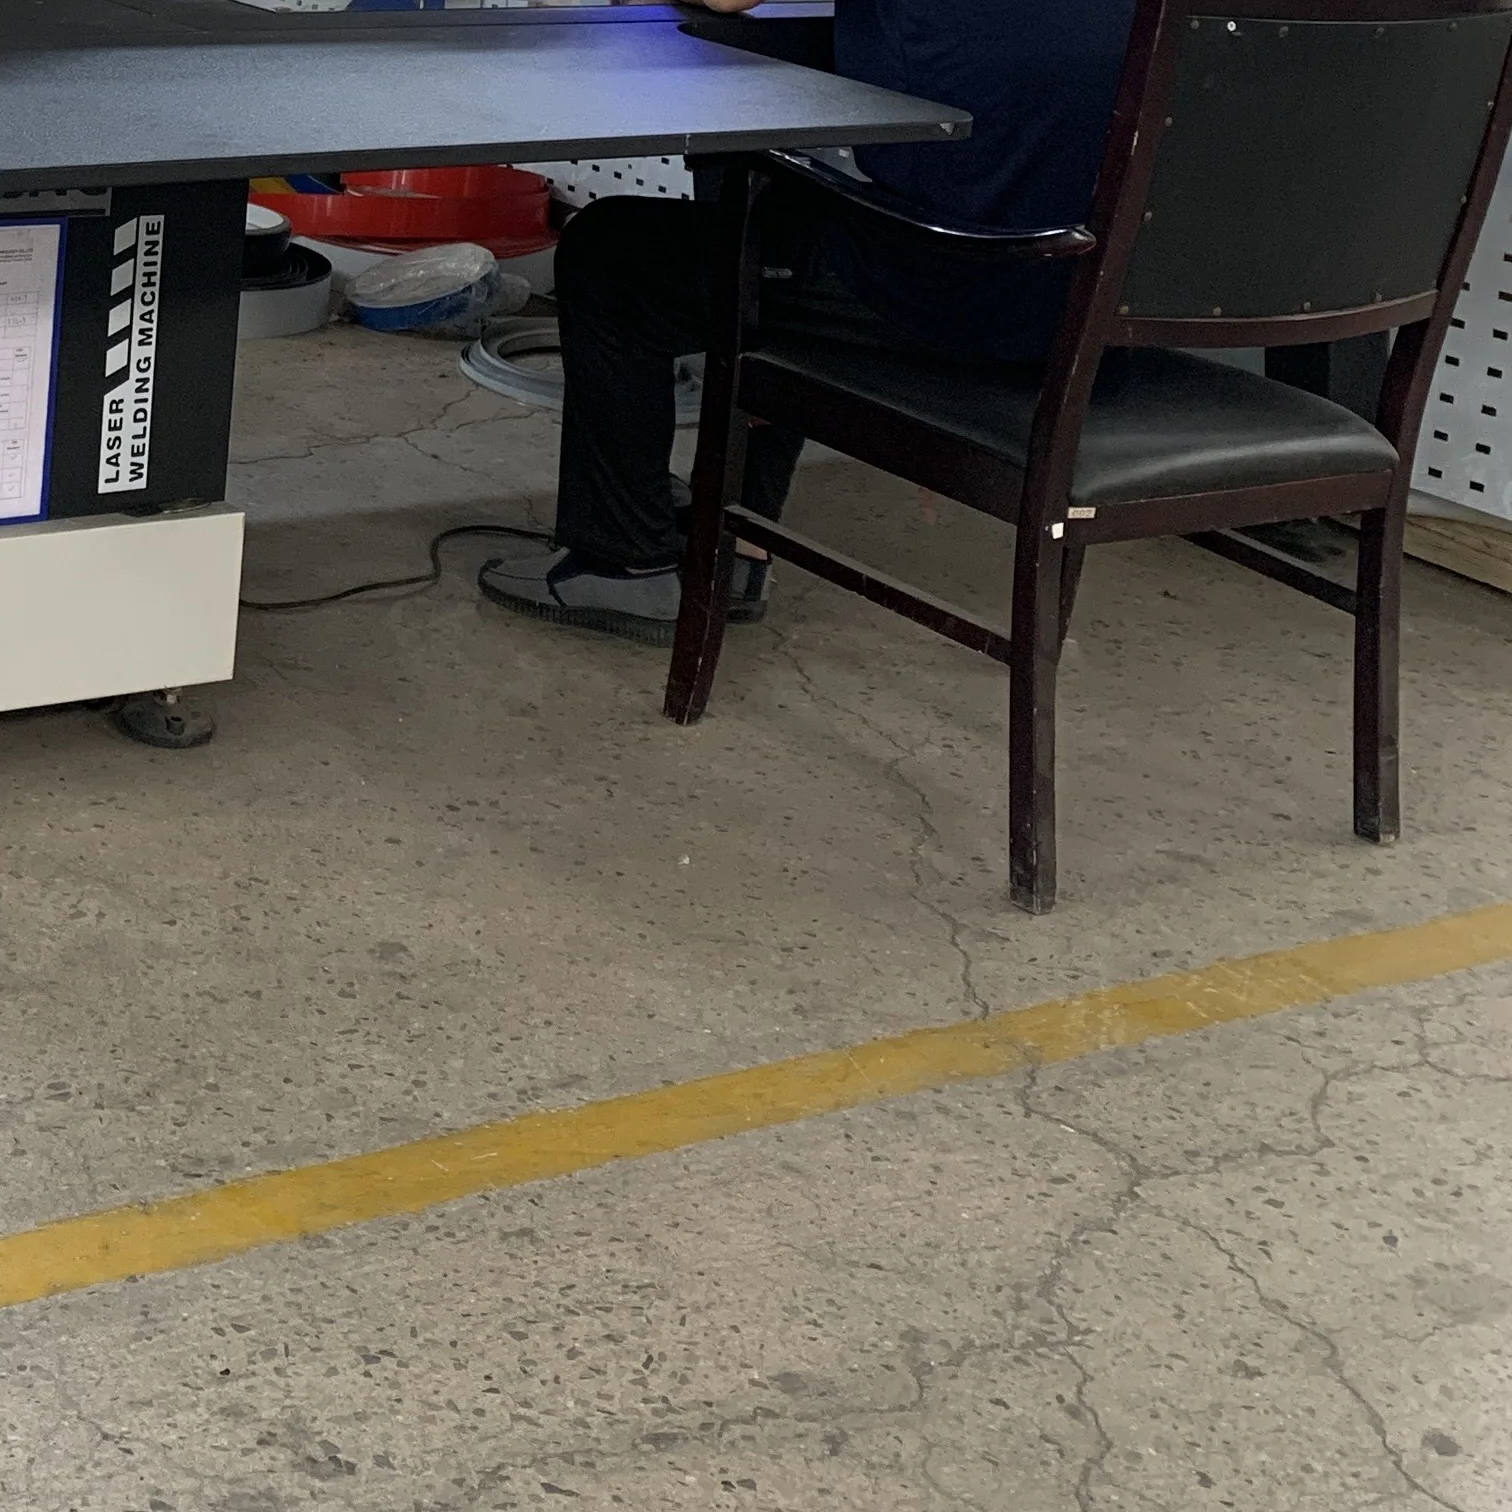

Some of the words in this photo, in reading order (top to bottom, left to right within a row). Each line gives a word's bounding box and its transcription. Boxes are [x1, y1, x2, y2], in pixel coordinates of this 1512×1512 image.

[137, 220, 161, 347] MACHINE
[104, 398, 125, 484] LASER
[128, 356, 152, 483] WELDING
